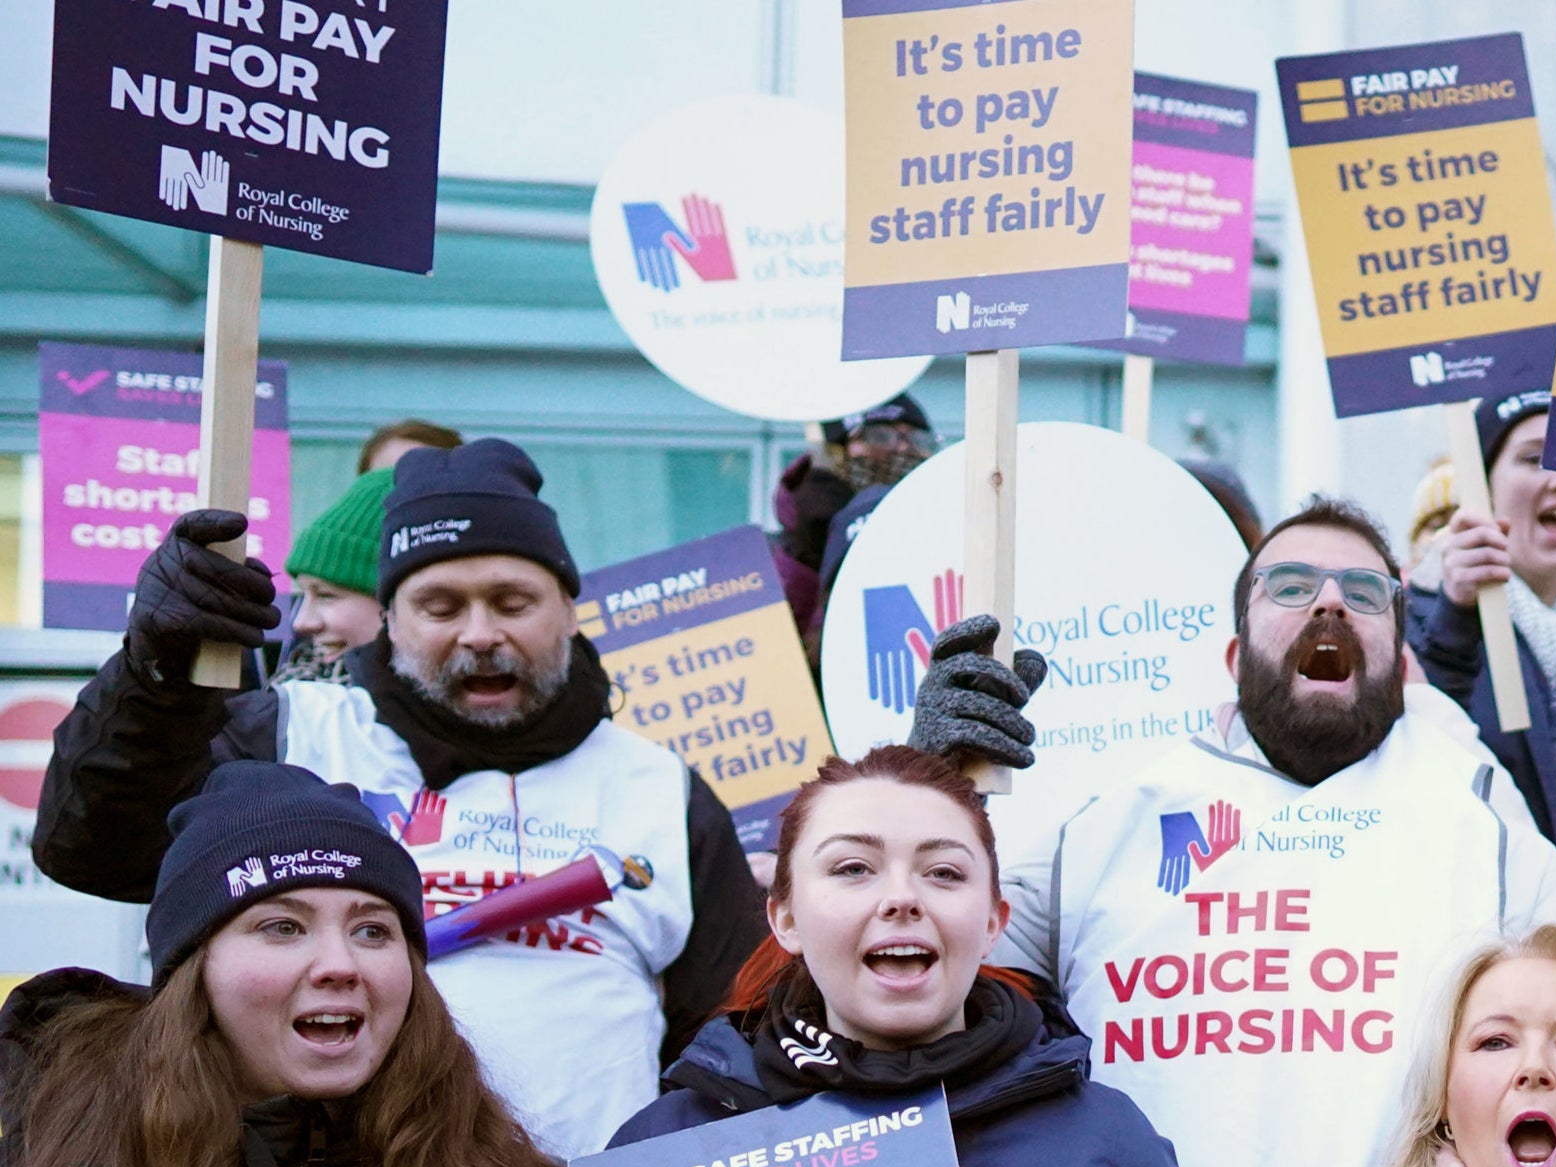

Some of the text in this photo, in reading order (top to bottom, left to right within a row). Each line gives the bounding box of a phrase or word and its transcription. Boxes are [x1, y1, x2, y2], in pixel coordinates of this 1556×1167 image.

[280, 0, 395, 64] PAY
[896, 25, 1082, 76] It's time
[195, 32, 319, 101] FOR
[1351, 66, 1459, 96] FAIR PAY
[110, 66, 390, 169] NURSING
[918, 87, 1059, 132] to pay
[1356, 80, 1516, 117] FOR NURSING
[901, 135, 1074, 186] nursing
[1338, 150, 1498, 191] It's time
[236, 206, 323, 240] of Nursing
[238, 182, 349, 224] Royal College
[869, 196, 974, 244] staff
[985, 187, 1105, 235] fairly
[1366, 195, 1486, 231] to pay
[1358, 233, 1510, 276] nursing
[1339, 268, 1542, 322] staff fairly
[606, 567, 708, 613] FAIR PAY
[1097, 599, 1215, 641] College
[667, 635, 755, 678] time
[1048, 650, 1171, 691] Nursing
[632, 676, 747, 727] to pay
[1113, 717, 1134, 742] in
[1141, 710, 1178, 738] the
[711, 736, 808, 782] fairly
[270, 849, 362, 868] Royal College
[1256, 830, 1345, 859] Nursing
[273, 863, 345, 881] of Nursing
[1185, 889, 1310, 936] THE
[1104, 948, 1398, 1003] VOICE OF
[1104, 1008, 1394, 1064] NURSING
[774, 1105, 923, 1164] STAFFING
